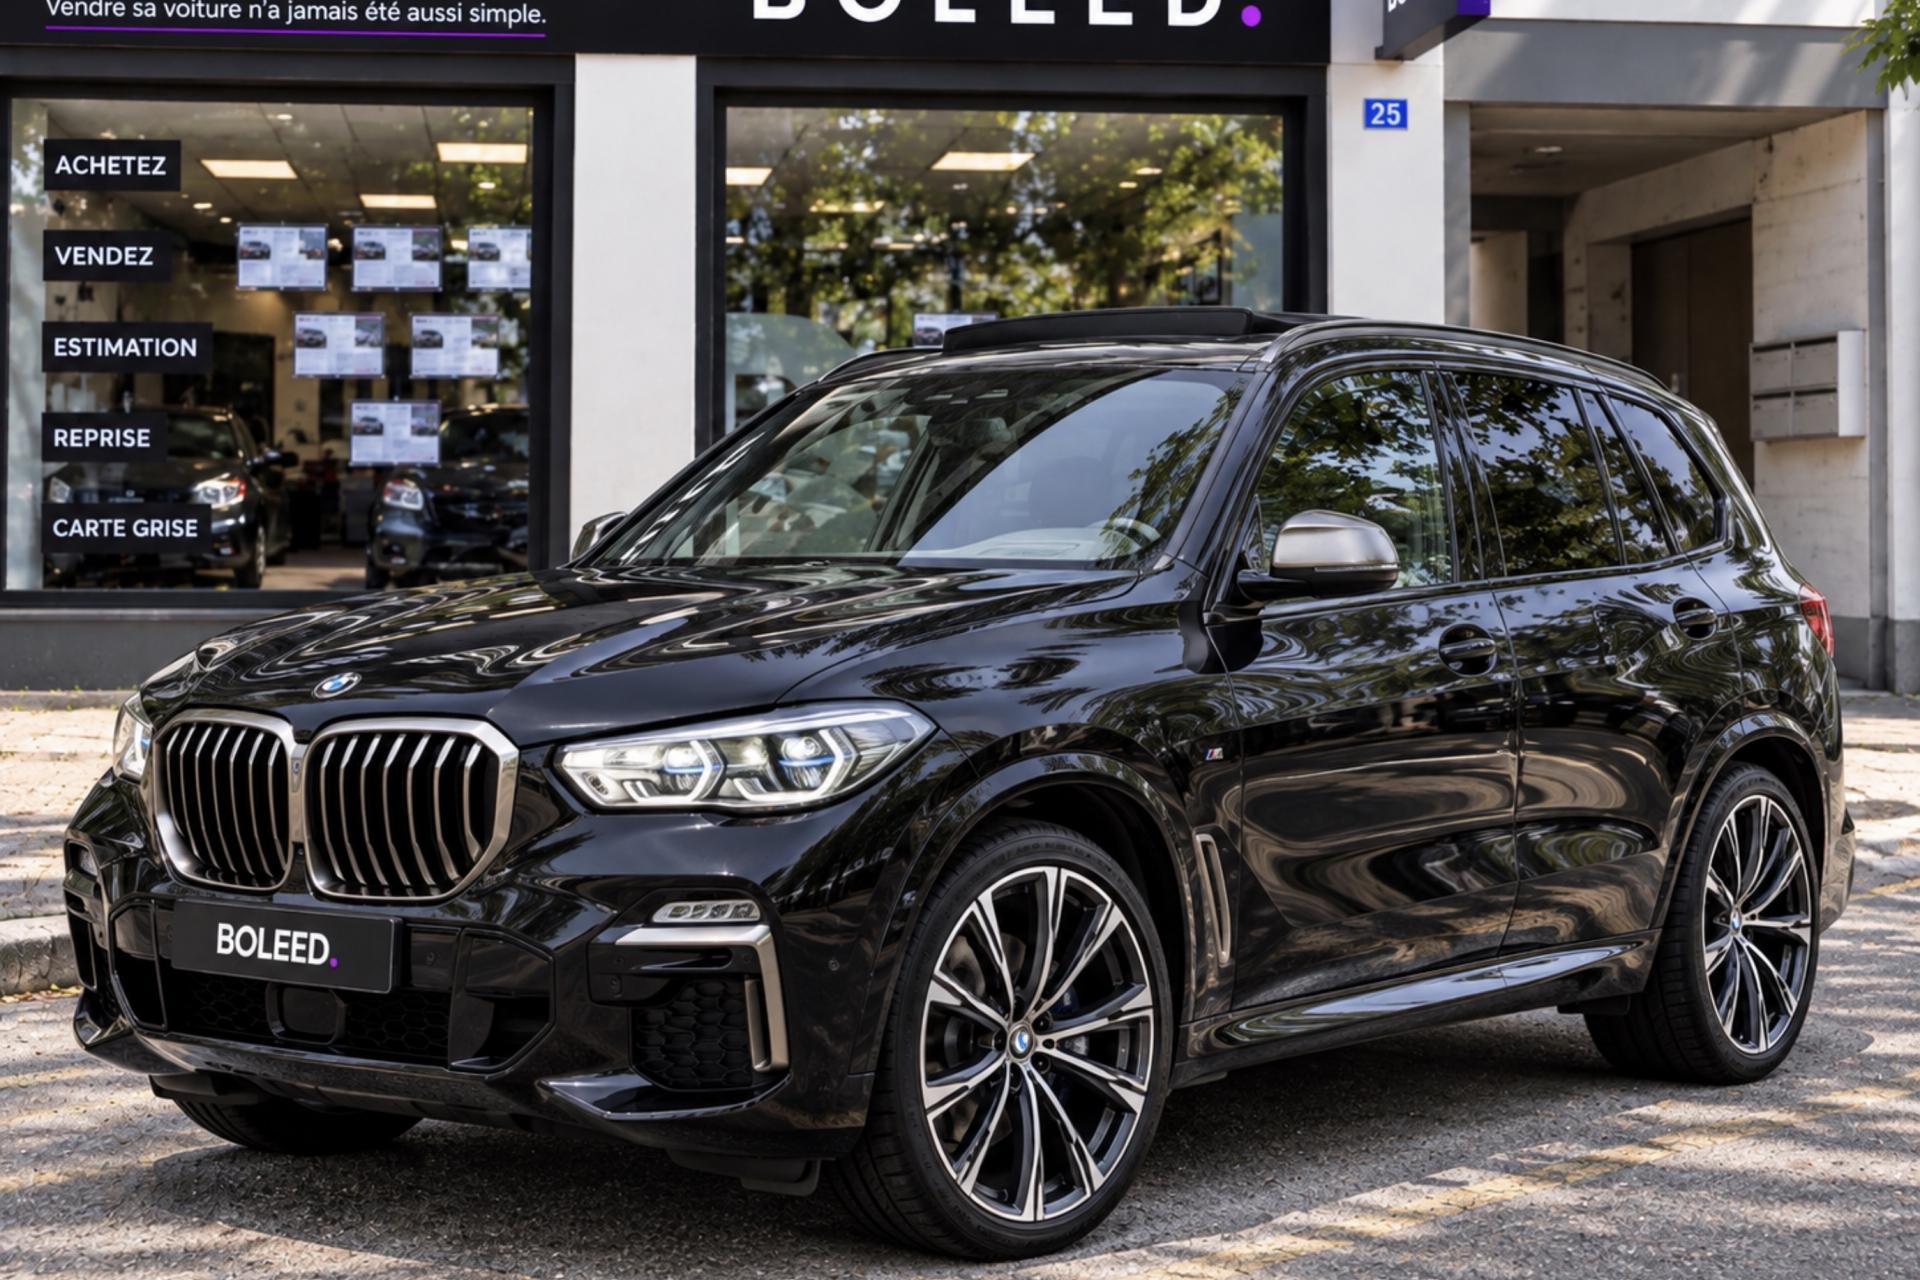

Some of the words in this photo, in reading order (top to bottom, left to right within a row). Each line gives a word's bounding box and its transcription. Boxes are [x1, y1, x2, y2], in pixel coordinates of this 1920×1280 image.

[45, 0, 126, 17] Vendre
[132, 1, 157, 18] sa
[163, 0, 242, 19] voiture
[248, 0, 281, 20] n'a
[285, 0, 359, 25] jamais
[364, 1, 401, 22] été
[406, 2, 463, 22] aussi
[469, 2, 547, 29] simple.
[1370, 102, 1401, 126] 25
[55, 155, 167, 176] ACHETEZ
[55, 246, 154, 266] VENDEZ
[54, 337, 197, 358] ESTIMATION
[53, 429, 151, 448] REPRISE
[52, 518, 126, 538] CARTE
[132, 518, 198, 538] GRISE
[216, 922, 339, 968] BOLEED.
